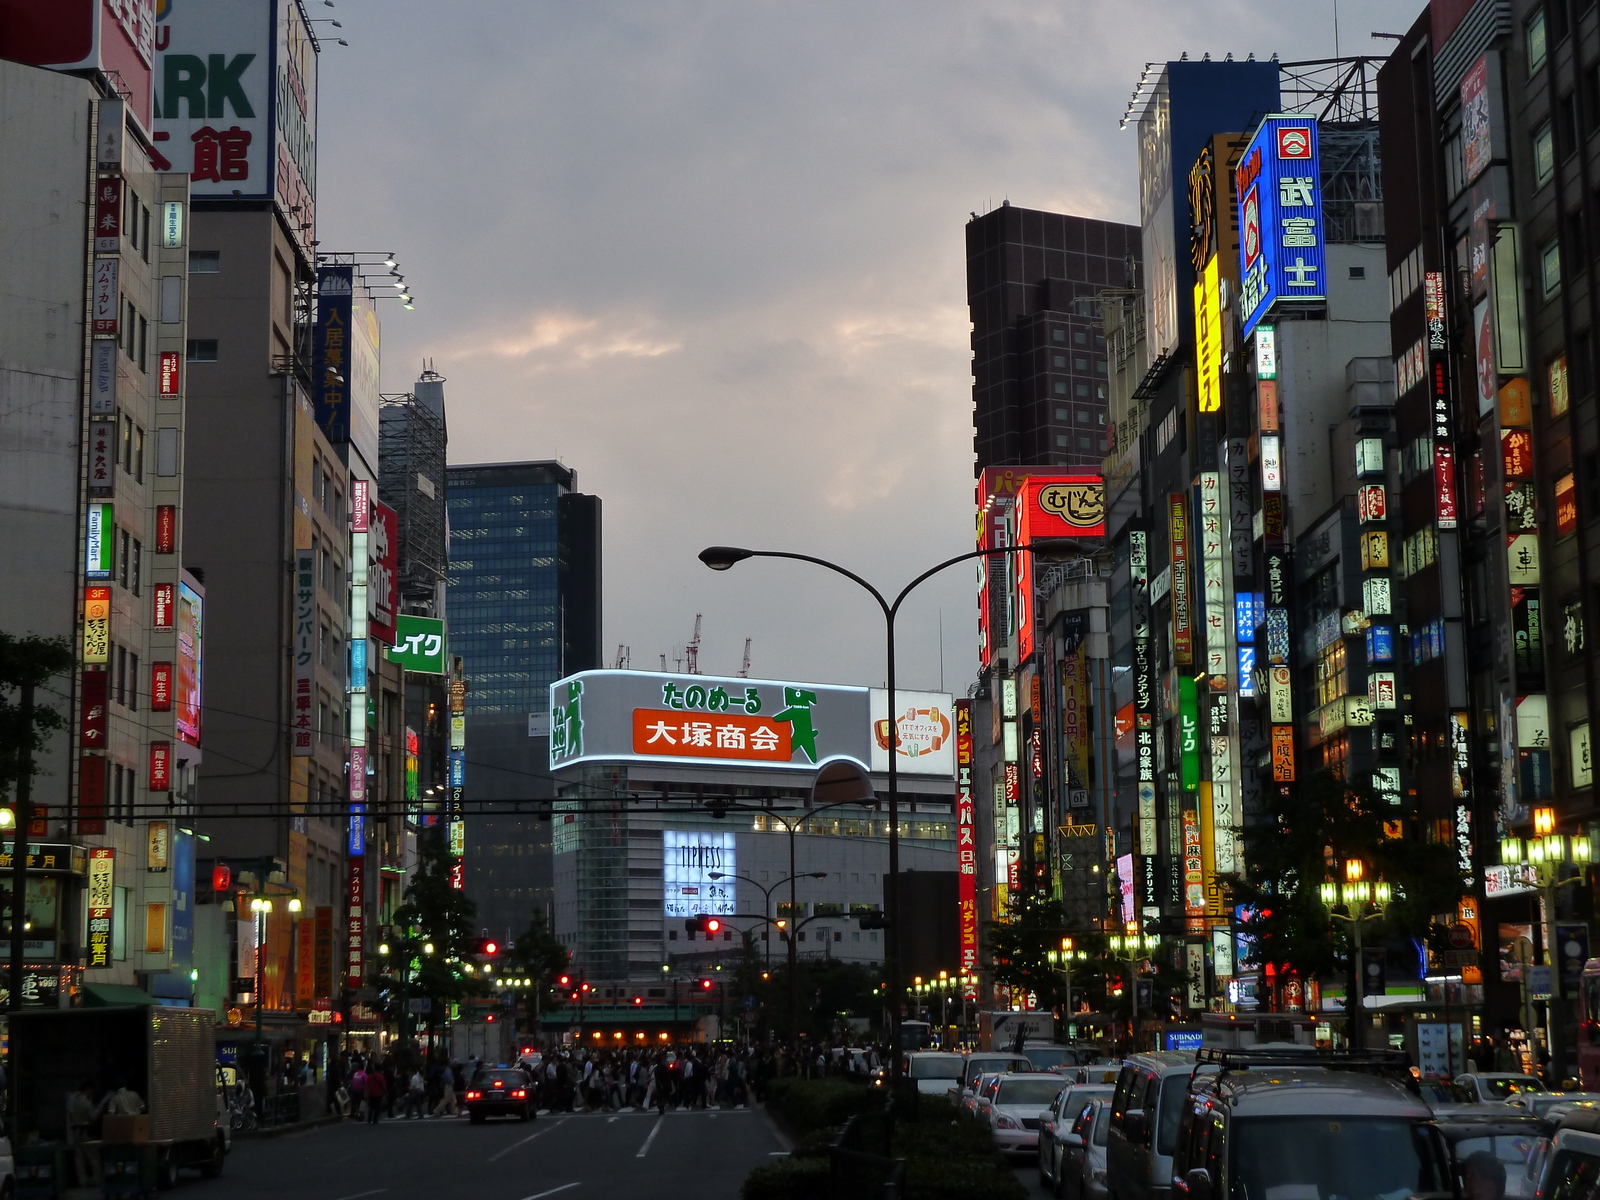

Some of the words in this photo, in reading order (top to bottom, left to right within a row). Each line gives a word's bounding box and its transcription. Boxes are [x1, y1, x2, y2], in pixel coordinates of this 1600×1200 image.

[153, 54, 256, 119] RK
[1279, 176, 1318, 288] 武富士
[97, 321, 114, 329] 5F
[94, 401, 111, 410] 4F
[1435, 399, 1448, 437] 東海苑
[1509, 433, 1524, 475] かまどか
[1232, 442, 1248, 524] カラオケ
[1439, 461, 1452, 504] さくら坂
[1204, 476, 1219, 554] カラオケ
[1264, 497, 1281, 537] 麻雀
[89, 511, 100, 562] FamilyMart
[91, 590, 105, 598] 3F
[1268, 555, 1284, 604] 今宮ビル
[297, 557, 313, 666] 新宿サンパーク
[1206, 577, 1223, 666] パセラ
[662, 682, 762, 714] たのめーる
[645, 720, 779, 751] 大塚商会
[902, 724, 937, 732] ITでオフィスを
[1183, 715, 1195, 752] レイク
[1138, 732, 1152, 780] 北の家族
[1073, 790, 1086, 803] 6F
[1216, 764, 1231, 815] ダーツ
[96, 850, 109, 858] 3F
[682, 840, 720, 872] TIPNESS
[1187, 845, 1200, 870] 麻雀
[94, 909, 107, 917] 2F
